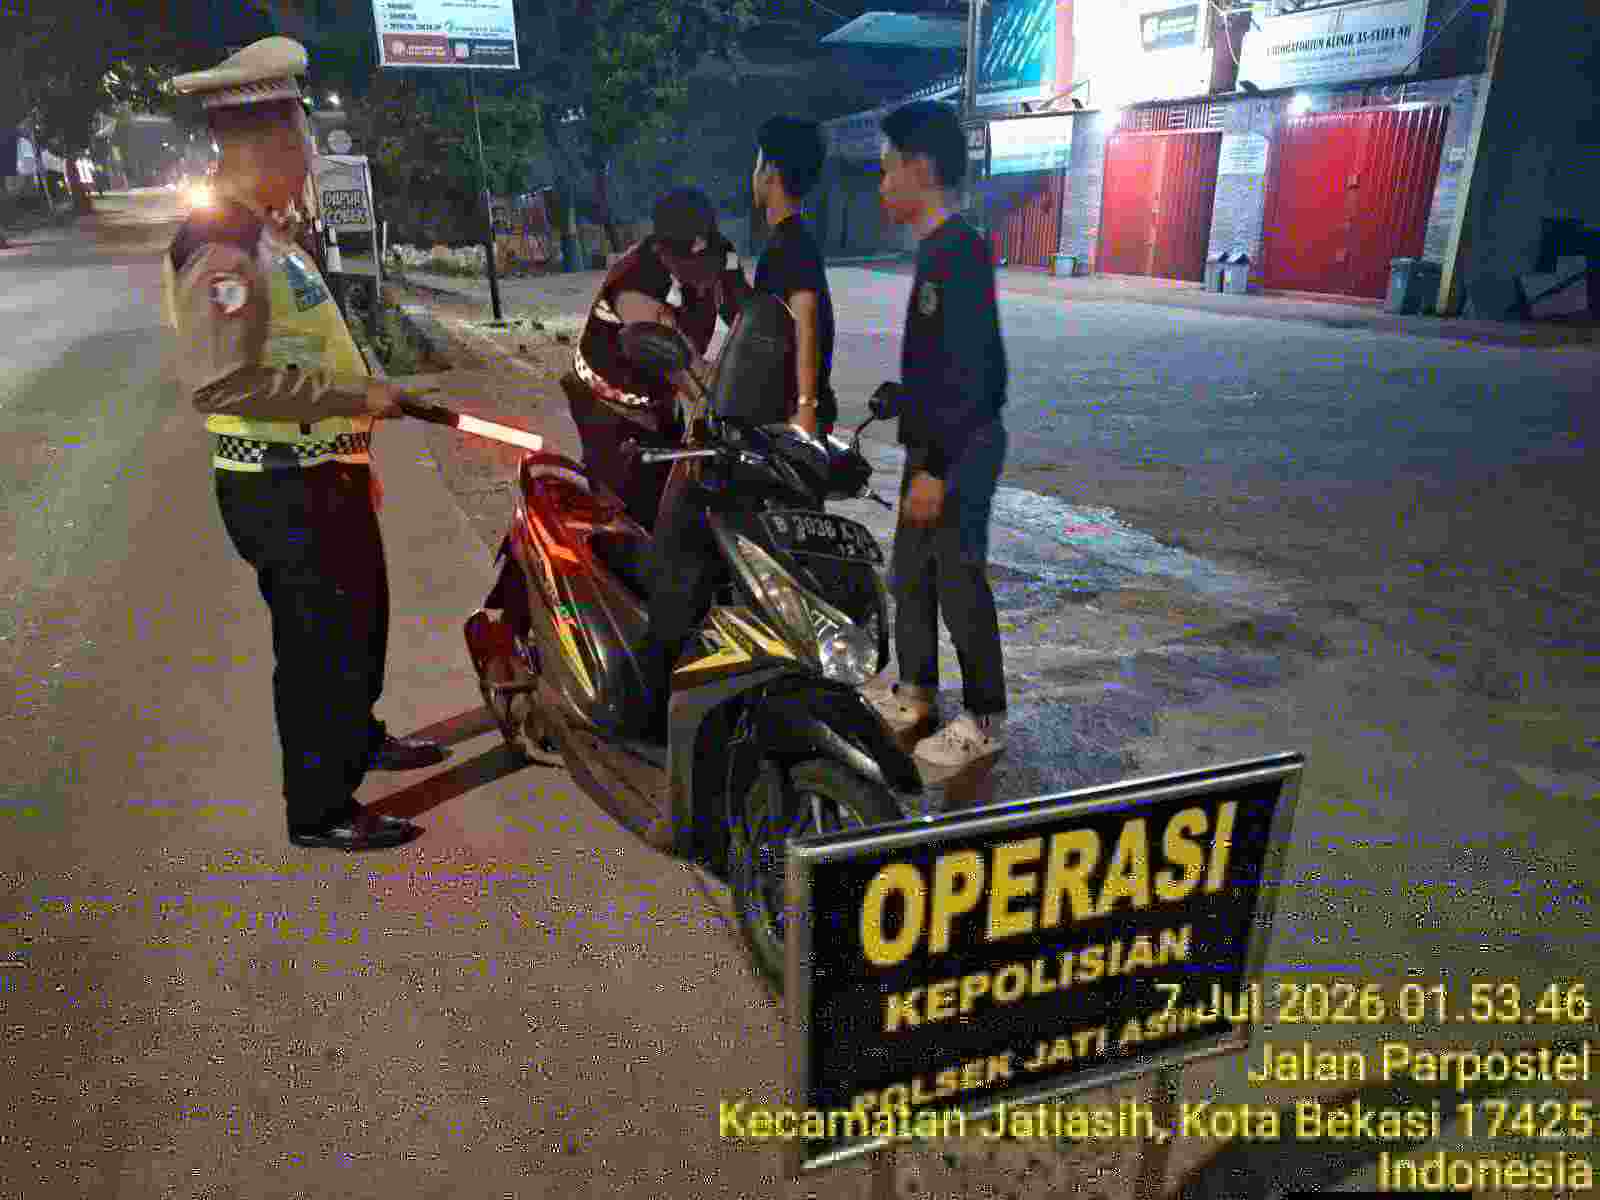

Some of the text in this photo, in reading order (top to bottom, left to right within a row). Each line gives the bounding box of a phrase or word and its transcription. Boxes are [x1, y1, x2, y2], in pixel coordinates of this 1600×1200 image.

[860, 800, 1237, 966] OPERASI
[885, 925, 1192, 1033] KEPOLISIAN
[1022, 1025, 1107, 1072] JATI
